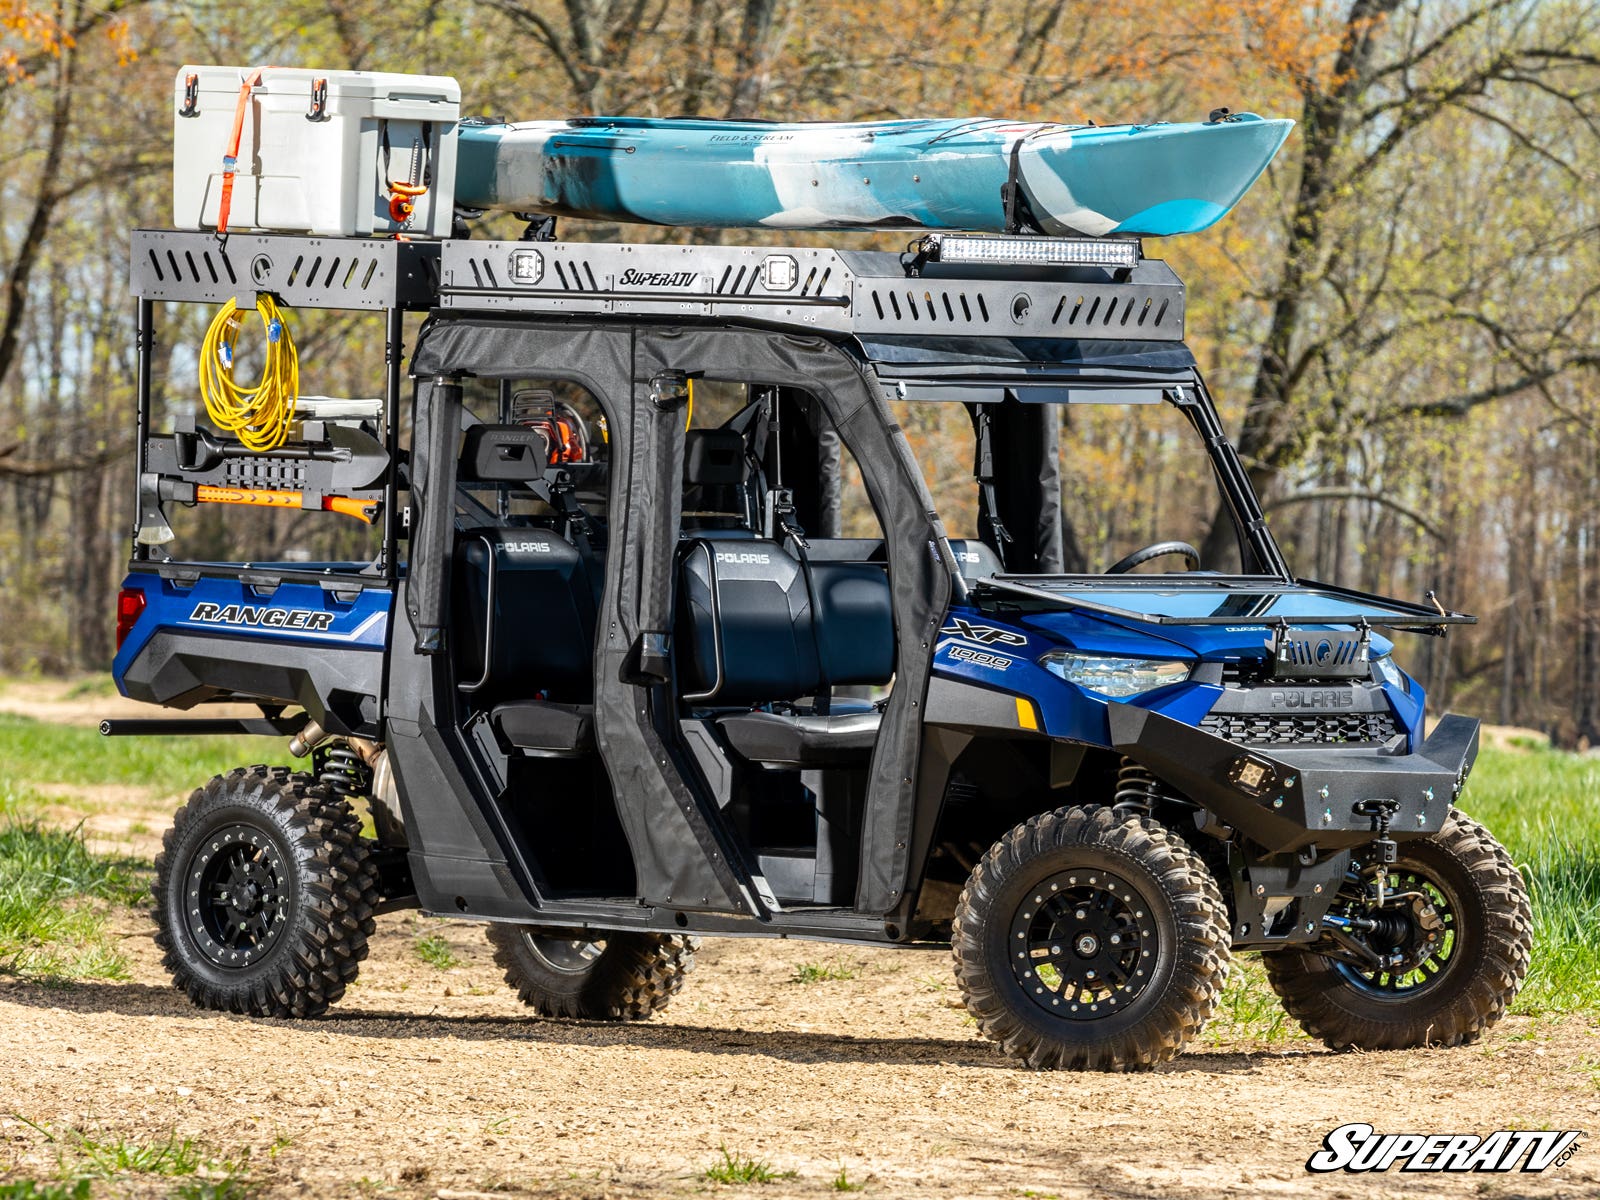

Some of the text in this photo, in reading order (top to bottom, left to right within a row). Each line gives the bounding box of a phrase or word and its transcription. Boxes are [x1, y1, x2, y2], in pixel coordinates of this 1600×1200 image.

[709, 134, 741, 142] FIELD
[619, 267, 699, 287] SUPERATV
[490, 434, 536, 442] RANGER
[495, 542, 551, 553] POLARIS
[715, 552, 770, 564] POLARIS
[189, 601, 335, 631] RANGER
[939, 617, 1028, 646] XP
[948, 645, 1013, 669] 1000
[1271, 690, 1354, 708] POLARIS
